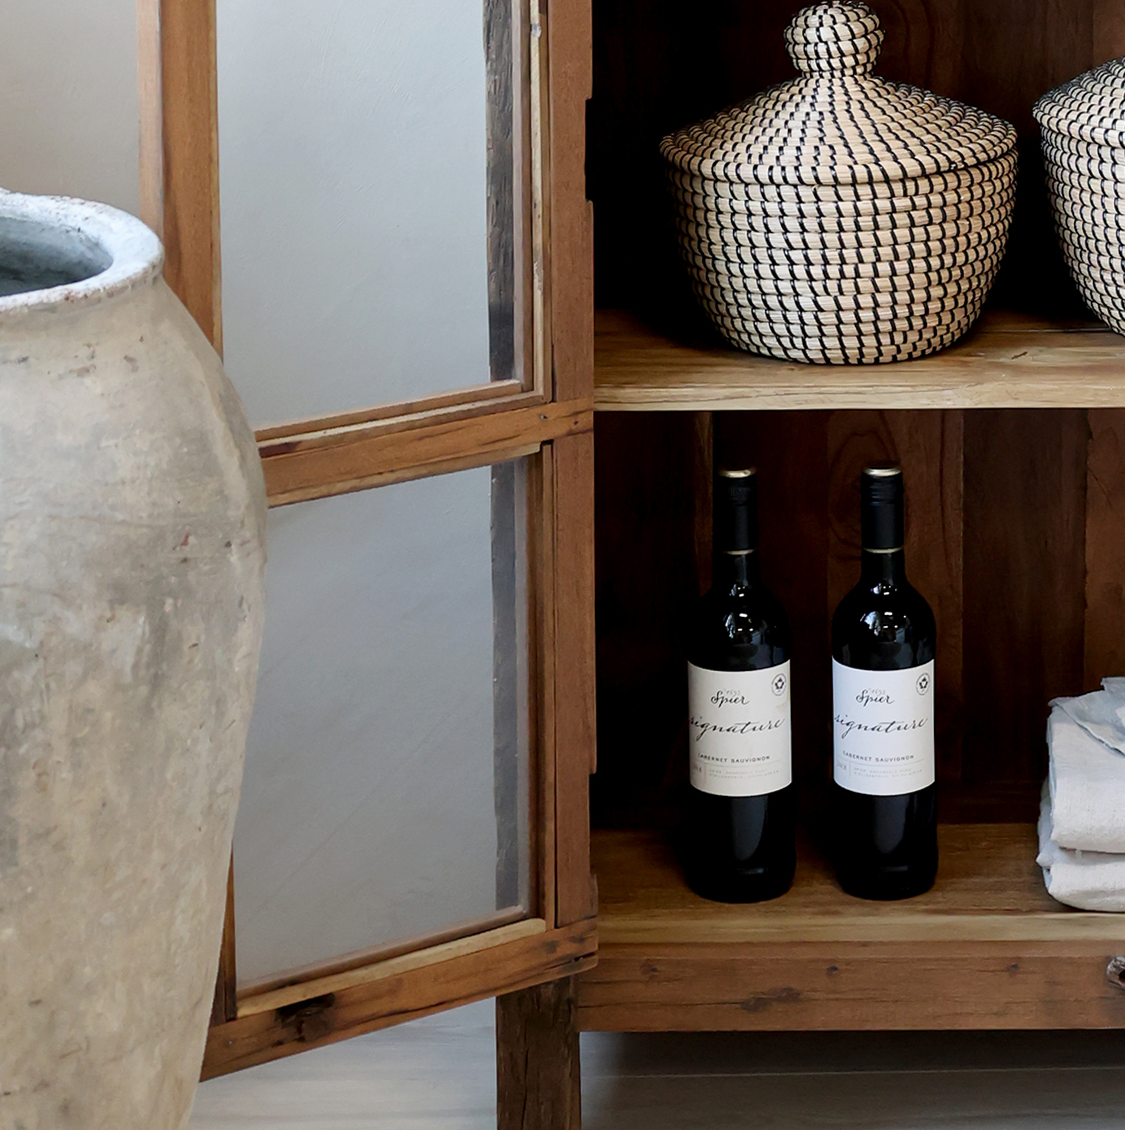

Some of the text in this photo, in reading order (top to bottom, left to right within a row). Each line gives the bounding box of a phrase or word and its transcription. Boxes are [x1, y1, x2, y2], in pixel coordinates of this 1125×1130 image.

[711, 690, 750, 708] Spier
[856, 689, 895, 707] Spier
[834, 714, 928, 739] signature
[698, 753, 770, 763] CABERNET SAUVIGNON
[842, 750, 914, 763] CABERNET SAUVIGNON
